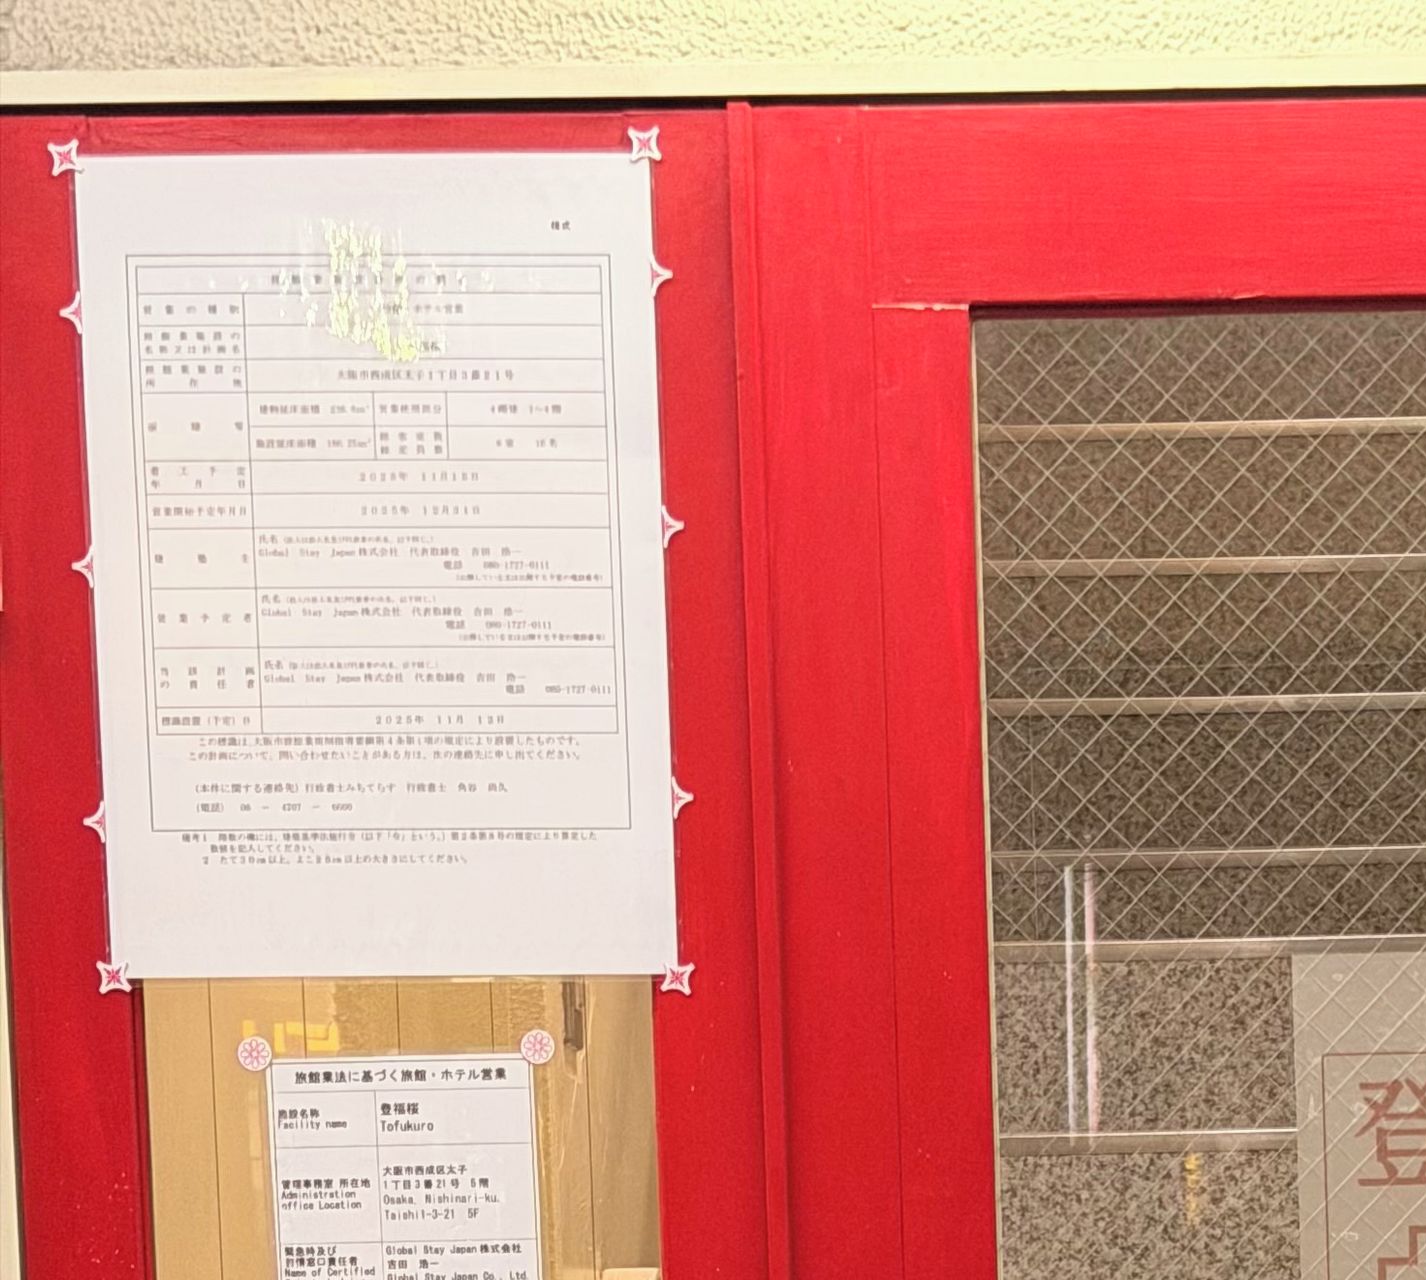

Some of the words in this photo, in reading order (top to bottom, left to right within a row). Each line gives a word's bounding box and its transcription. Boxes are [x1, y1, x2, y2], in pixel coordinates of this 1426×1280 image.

[278, 1120, 320, 1130] Facility
[380, 1120, 434, 1132] Tofukuro
[382, 1164, 467, 1177] 大阪市西成区太子
[339, 1178, 371, 1189] 所在地
[281, 1190, 356, 1200] Administration
[281, 1201, 314, 1210] office
[319, 1200, 362, 1210] Location
[467, 1207, 480, 1219] 5F
[385, 1245, 418, 1256] Global
[423, 1244, 446, 1256] Stay
[450, 1244, 477, 1255] Japan
[479, 1243, 522, 1254] 株式会社
[284, 1268, 307, 1277] Name
[311, 1267, 321, 1277] of
[327, 1266, 375, 1277] Certified
